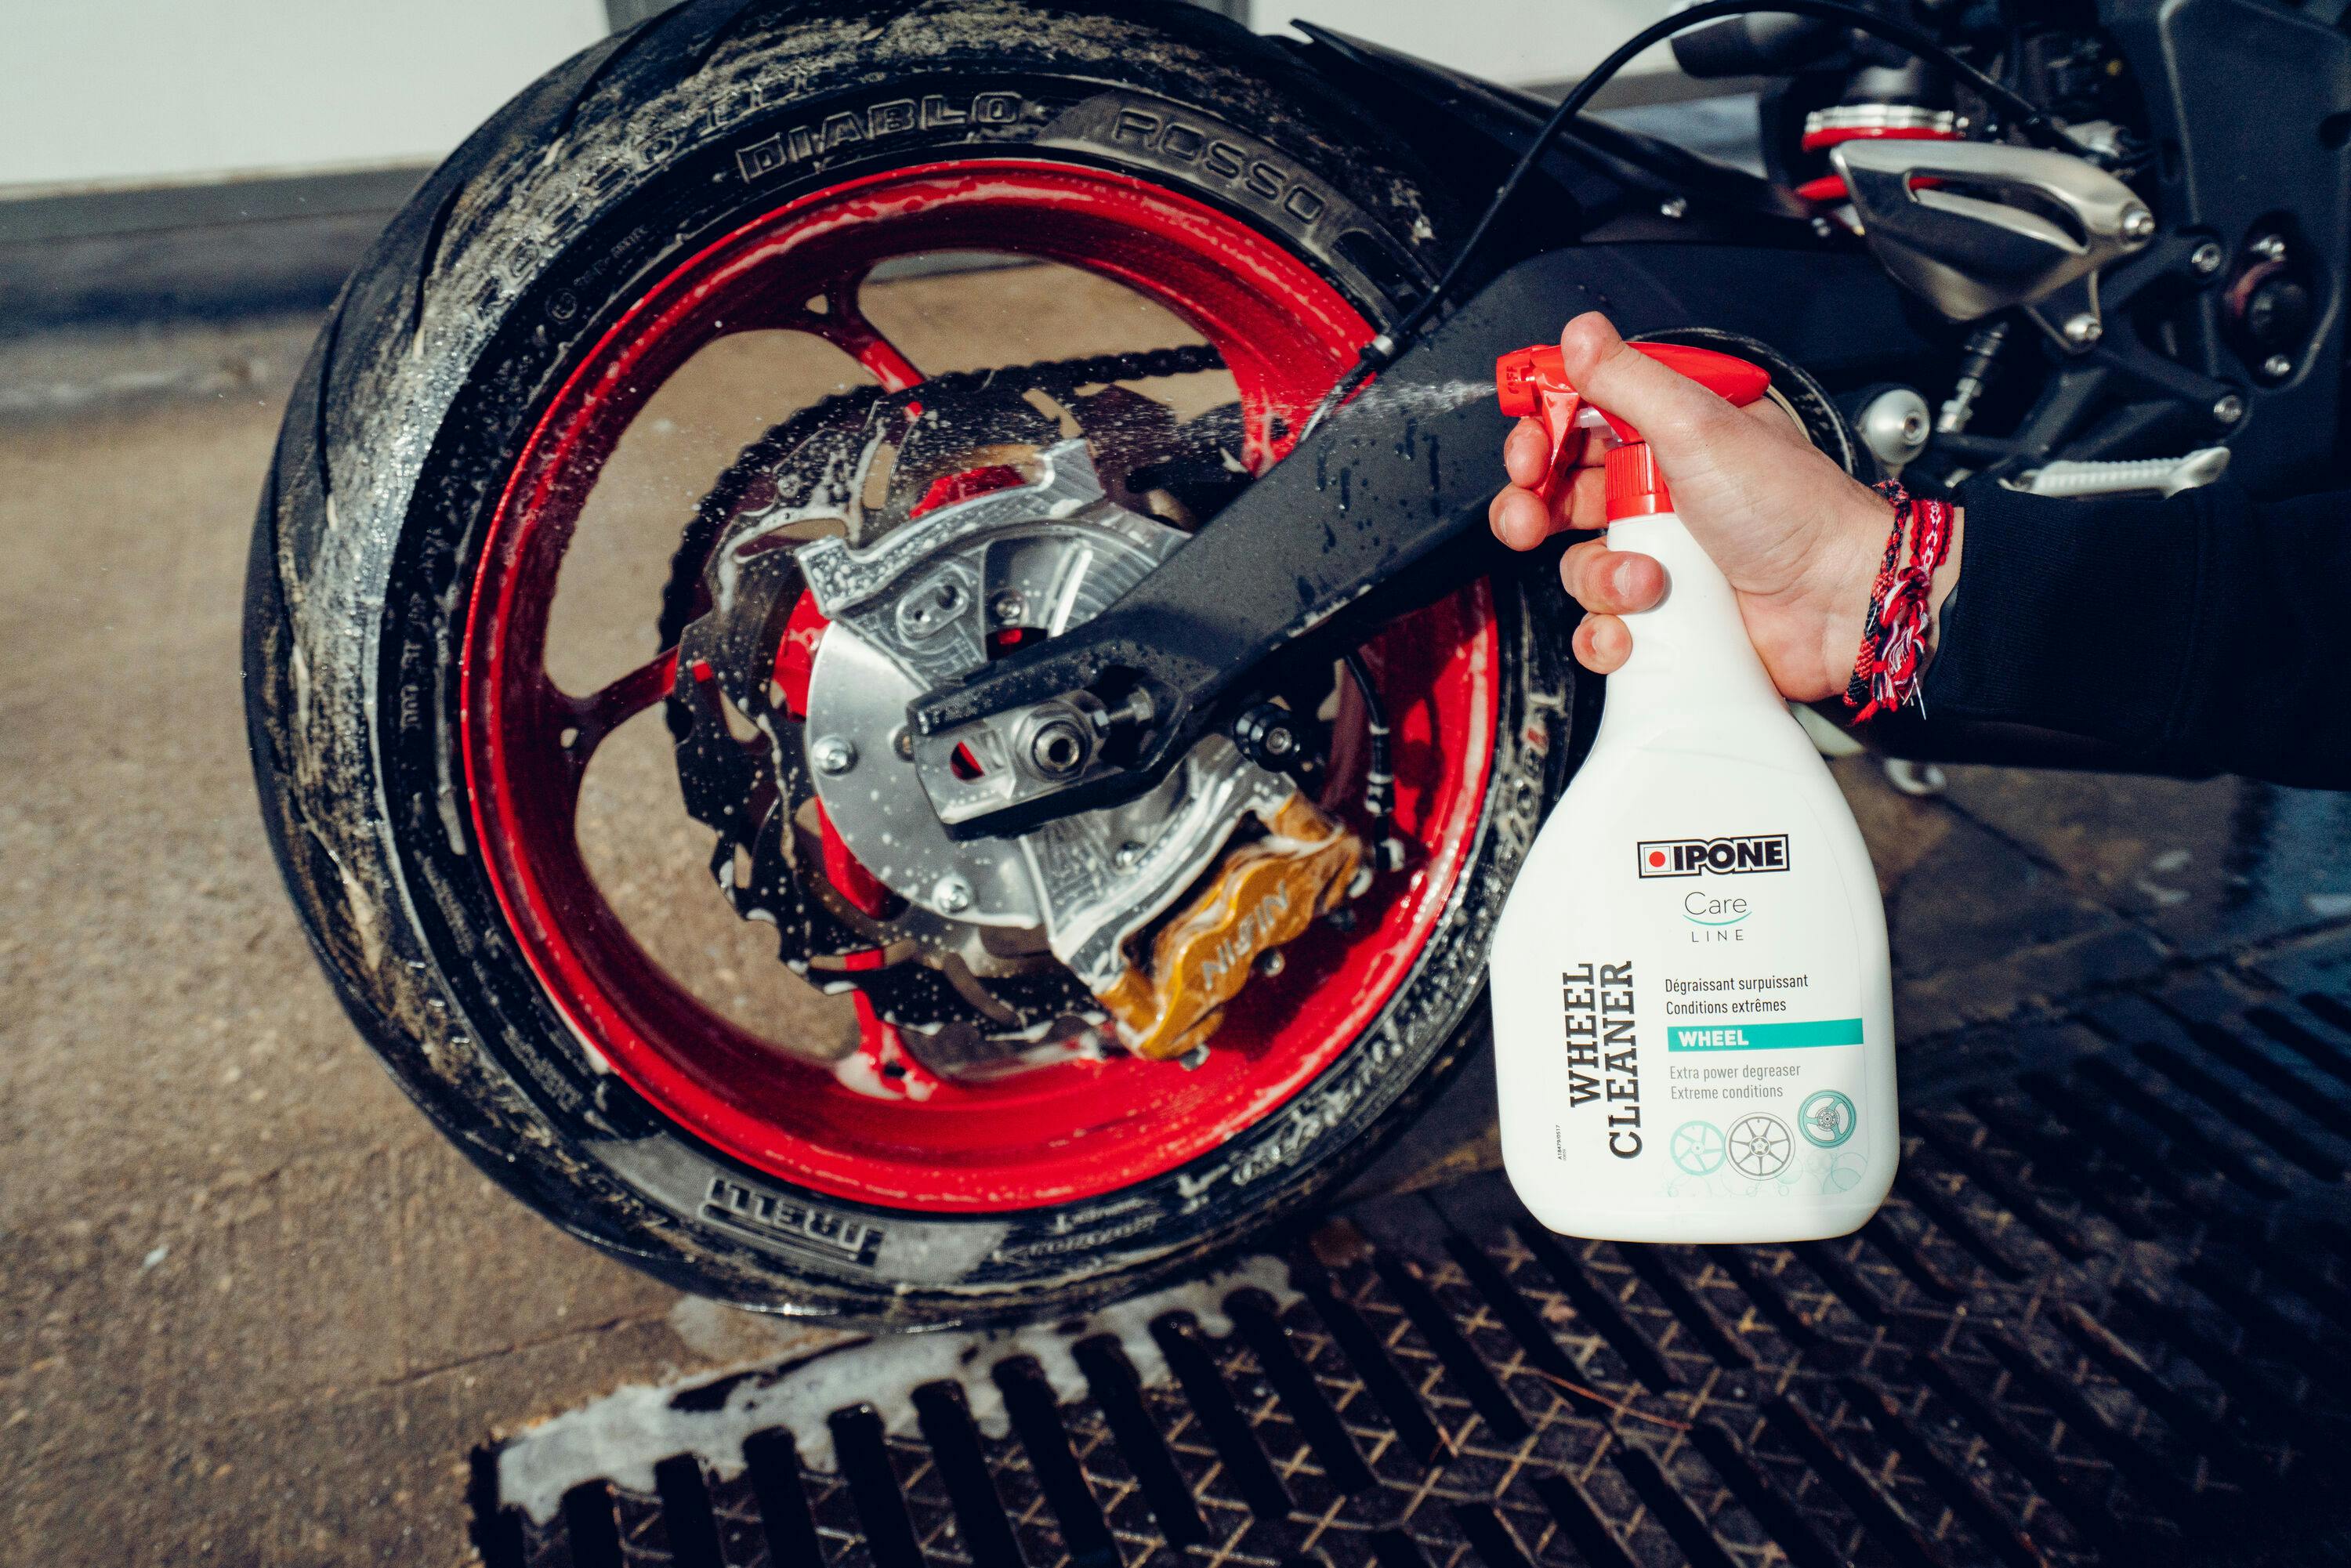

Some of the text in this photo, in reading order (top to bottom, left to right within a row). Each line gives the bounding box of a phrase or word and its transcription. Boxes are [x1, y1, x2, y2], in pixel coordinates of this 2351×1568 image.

[736, 91, 1326, 226] DIABLO ROSSO
[1505, 365, 1520, 395] OFF
[1673, 840, 1784, 871] IPONE
[1685, 892, 1747, 914] Care
[1691, 929, 1744, 943] LINE
[1665, 974, 1809, 995] Dégraissant surpuissant
[1666, 998, 1787, 1016] Conditions extrêmes
[1563, 962, 1601, 1108] WHEEL
[1678, 1030, 1749, 1047] WHEEL
[1600, 961, 1643, 1160] CLEANER
[1670, 1063, 1802, 1082] Extra power degreaser
[1671, 1084, 1784, 1100] Extreme conditions
